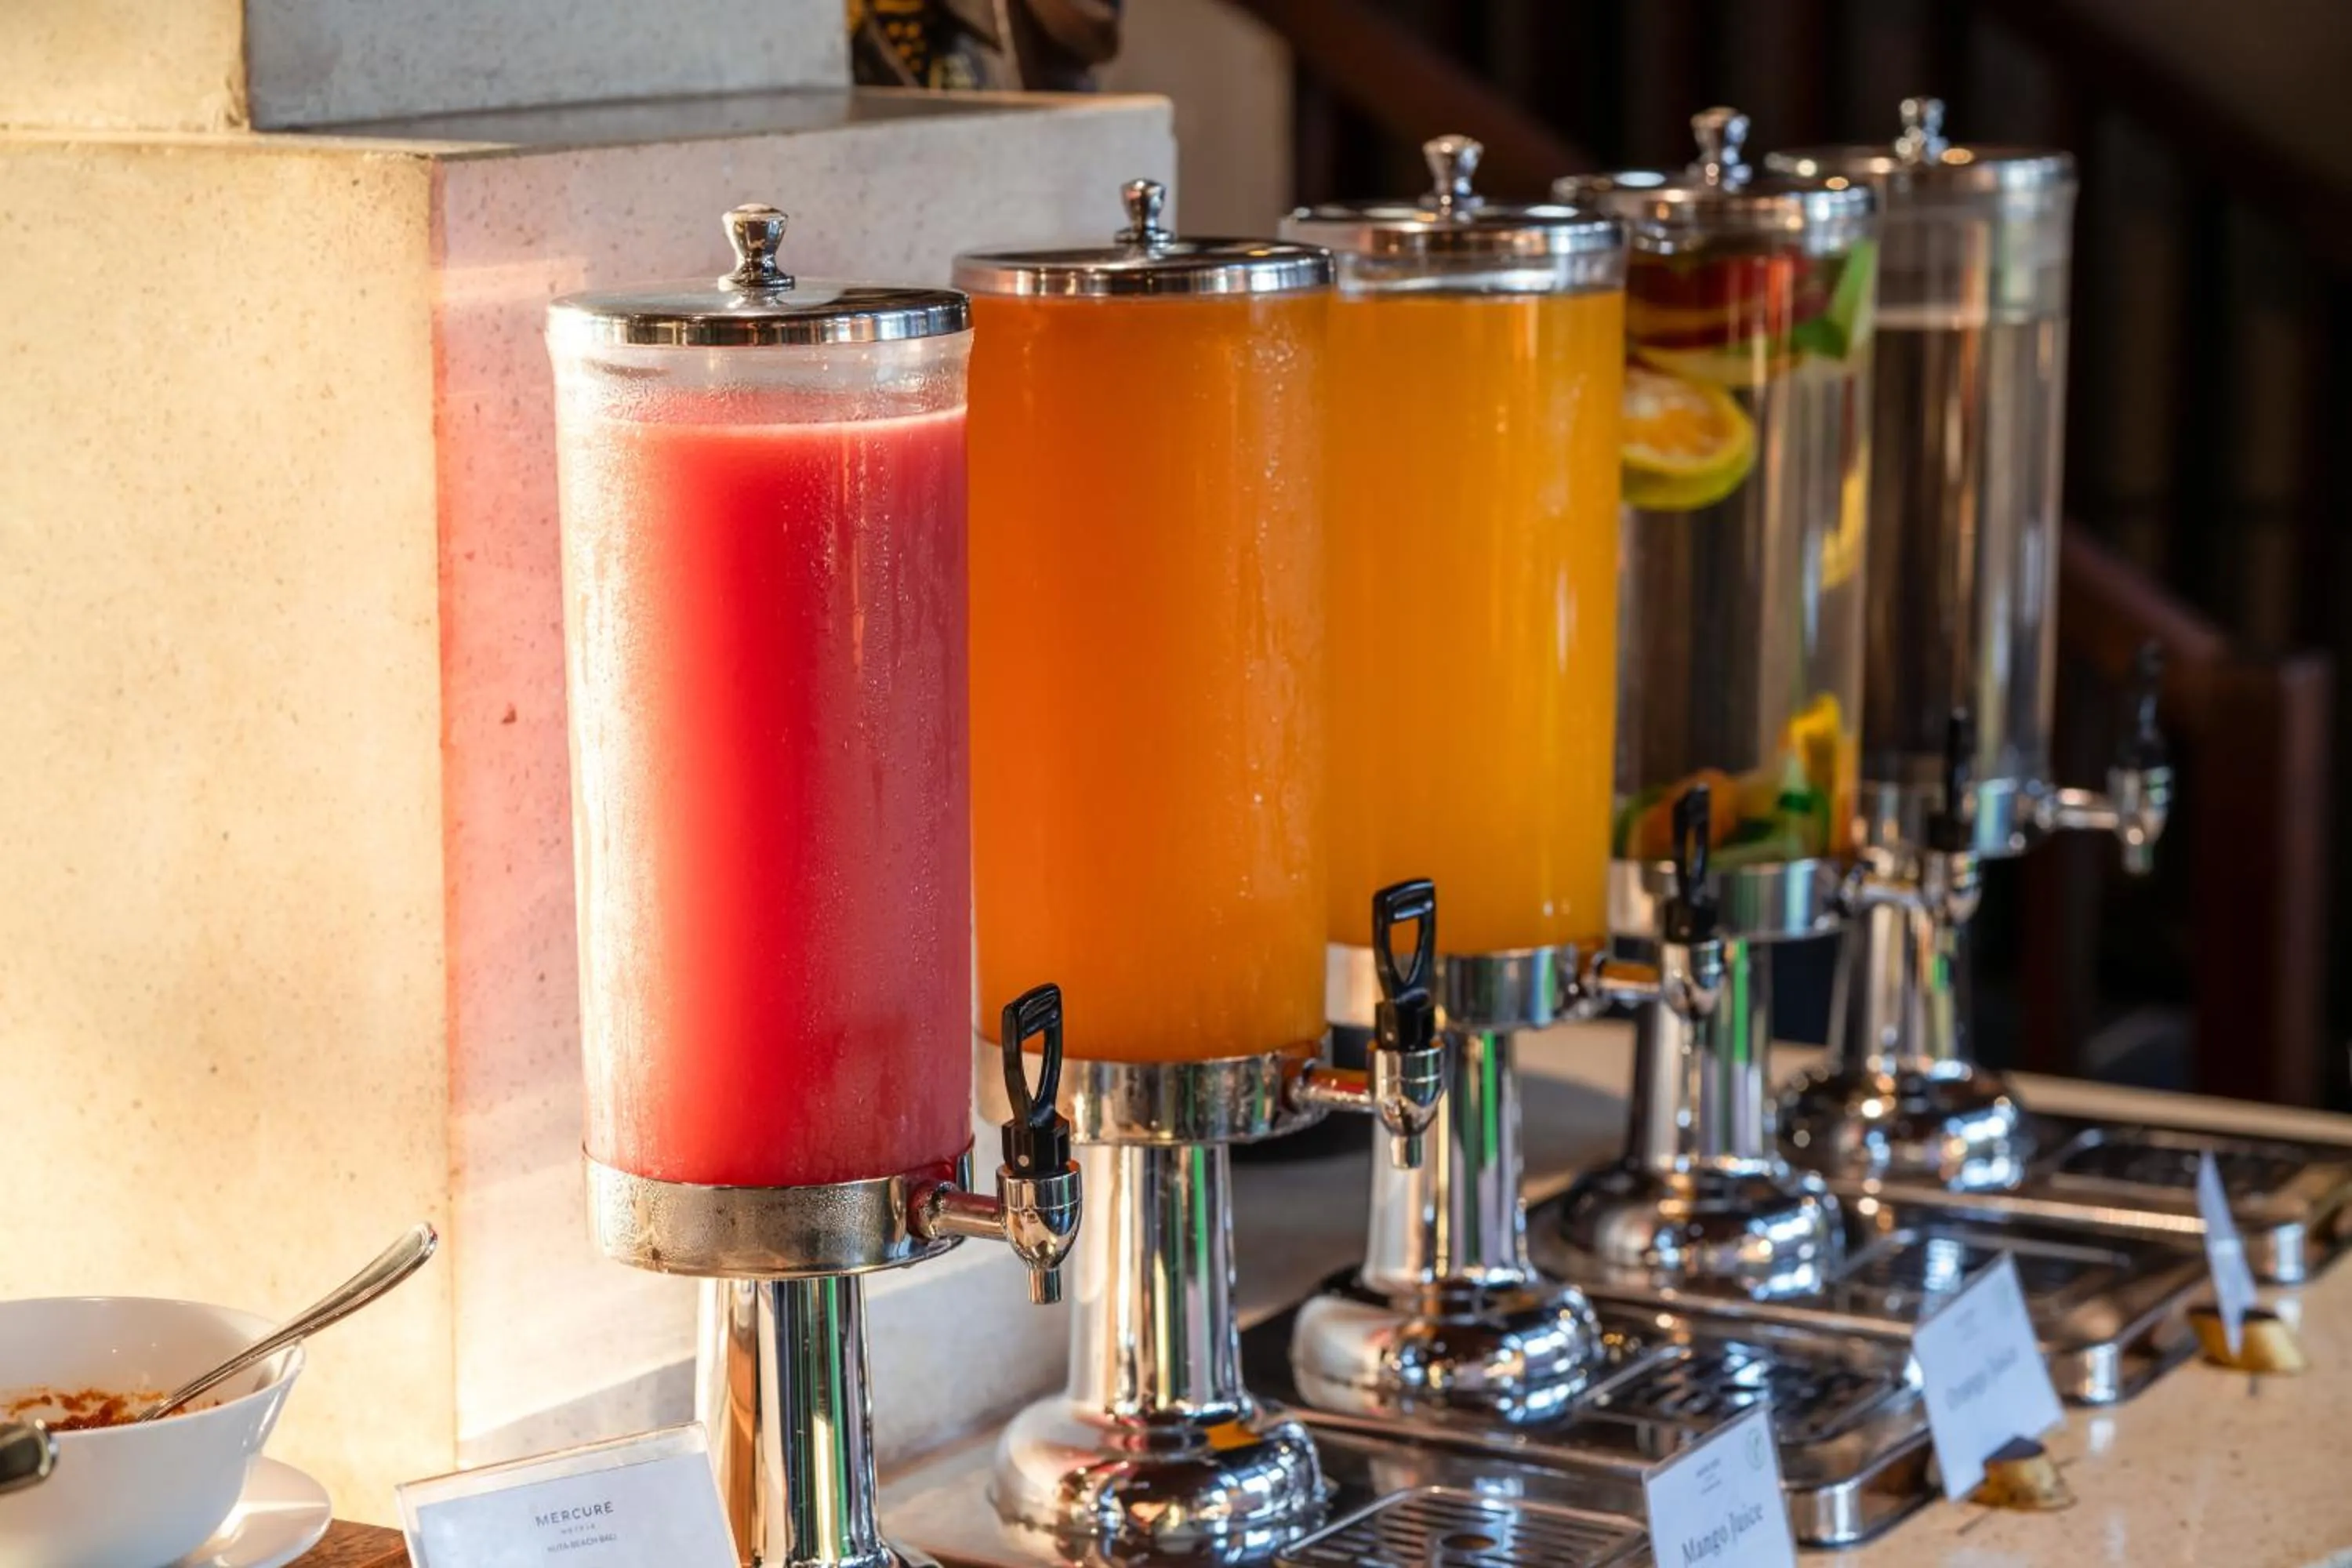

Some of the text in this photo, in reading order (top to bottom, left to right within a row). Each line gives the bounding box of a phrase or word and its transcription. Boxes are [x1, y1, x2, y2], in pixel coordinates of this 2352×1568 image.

[535, 1501, 614, 1527] MERCURE
[1681, 1503, 1763, 1568] Mango Juice
